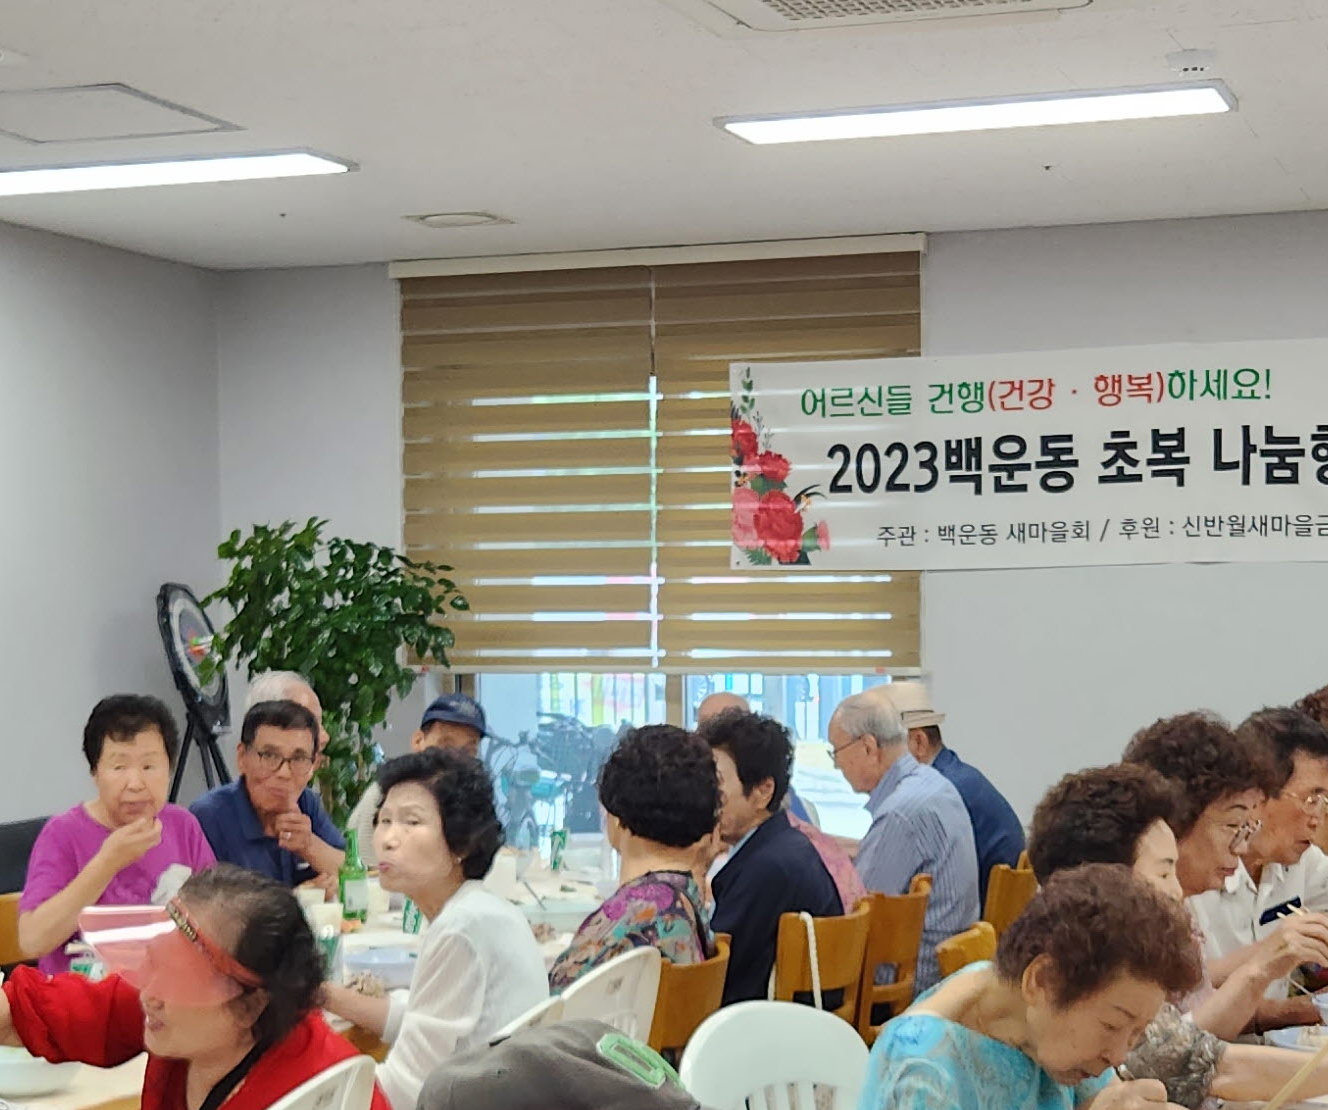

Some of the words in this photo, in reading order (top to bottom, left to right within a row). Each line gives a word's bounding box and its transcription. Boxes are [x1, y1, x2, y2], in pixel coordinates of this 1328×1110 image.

[800, 384, 913, 419] 어르신들
[927, 378, 1056, 415] 건행(건강
[1093, 367, 1272, 407] 행복)하세요!
[825, 432, 1080, 496] 2023백운동
[1096, 426, 1191, 488] 초복
[876, 525, 917, 548] 주관
[937, 523, 999, 546] 백운동
[1006, 519, 1091, 544] 새마을회
[1118, 516, 1162, 541] 후원
